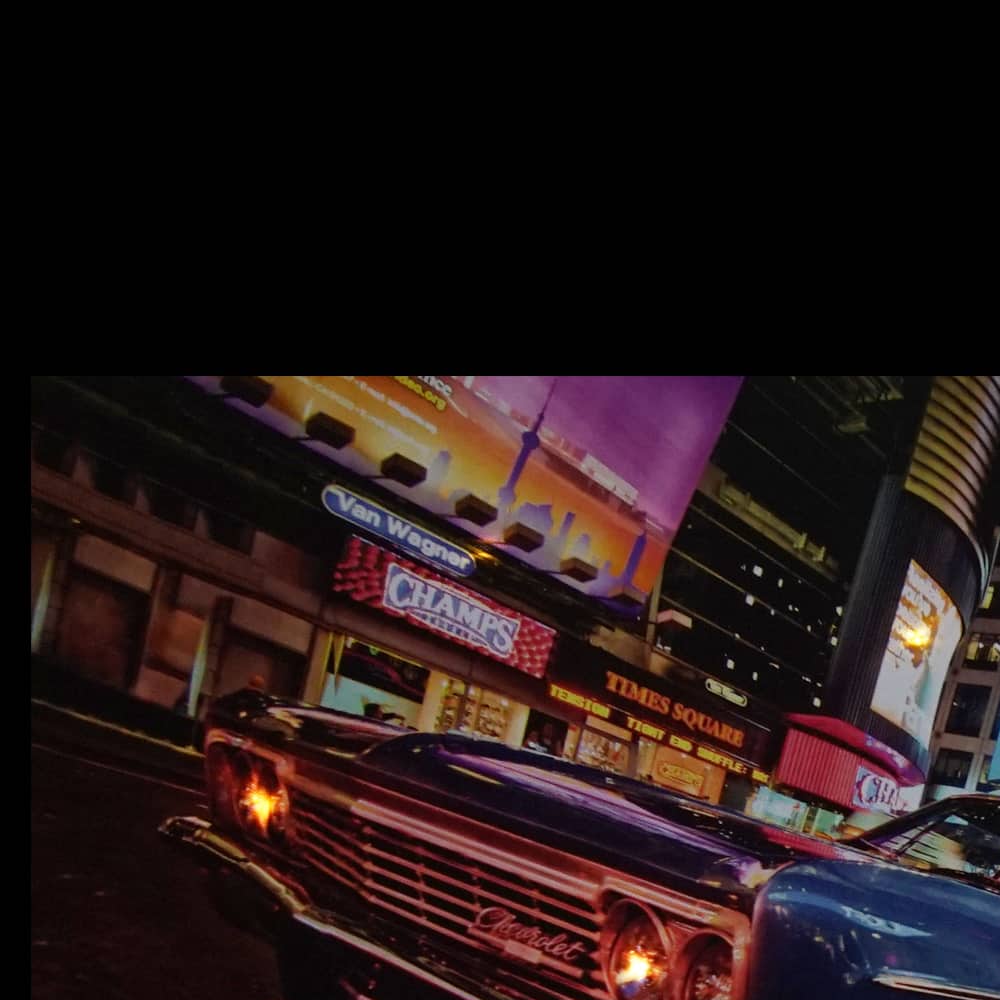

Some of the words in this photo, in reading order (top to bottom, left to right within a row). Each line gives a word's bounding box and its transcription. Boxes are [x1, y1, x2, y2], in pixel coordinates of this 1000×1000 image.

[332, 489, 382, 528] Van
[386, 515, 472, 570] Wagner
[388, 572, 515, 650] CHAMPS
[606, 670, 672, 715] TIMES
[672, 702, 745, 748] SQUARE
[475, 906, 586, 960] Chevrolet
